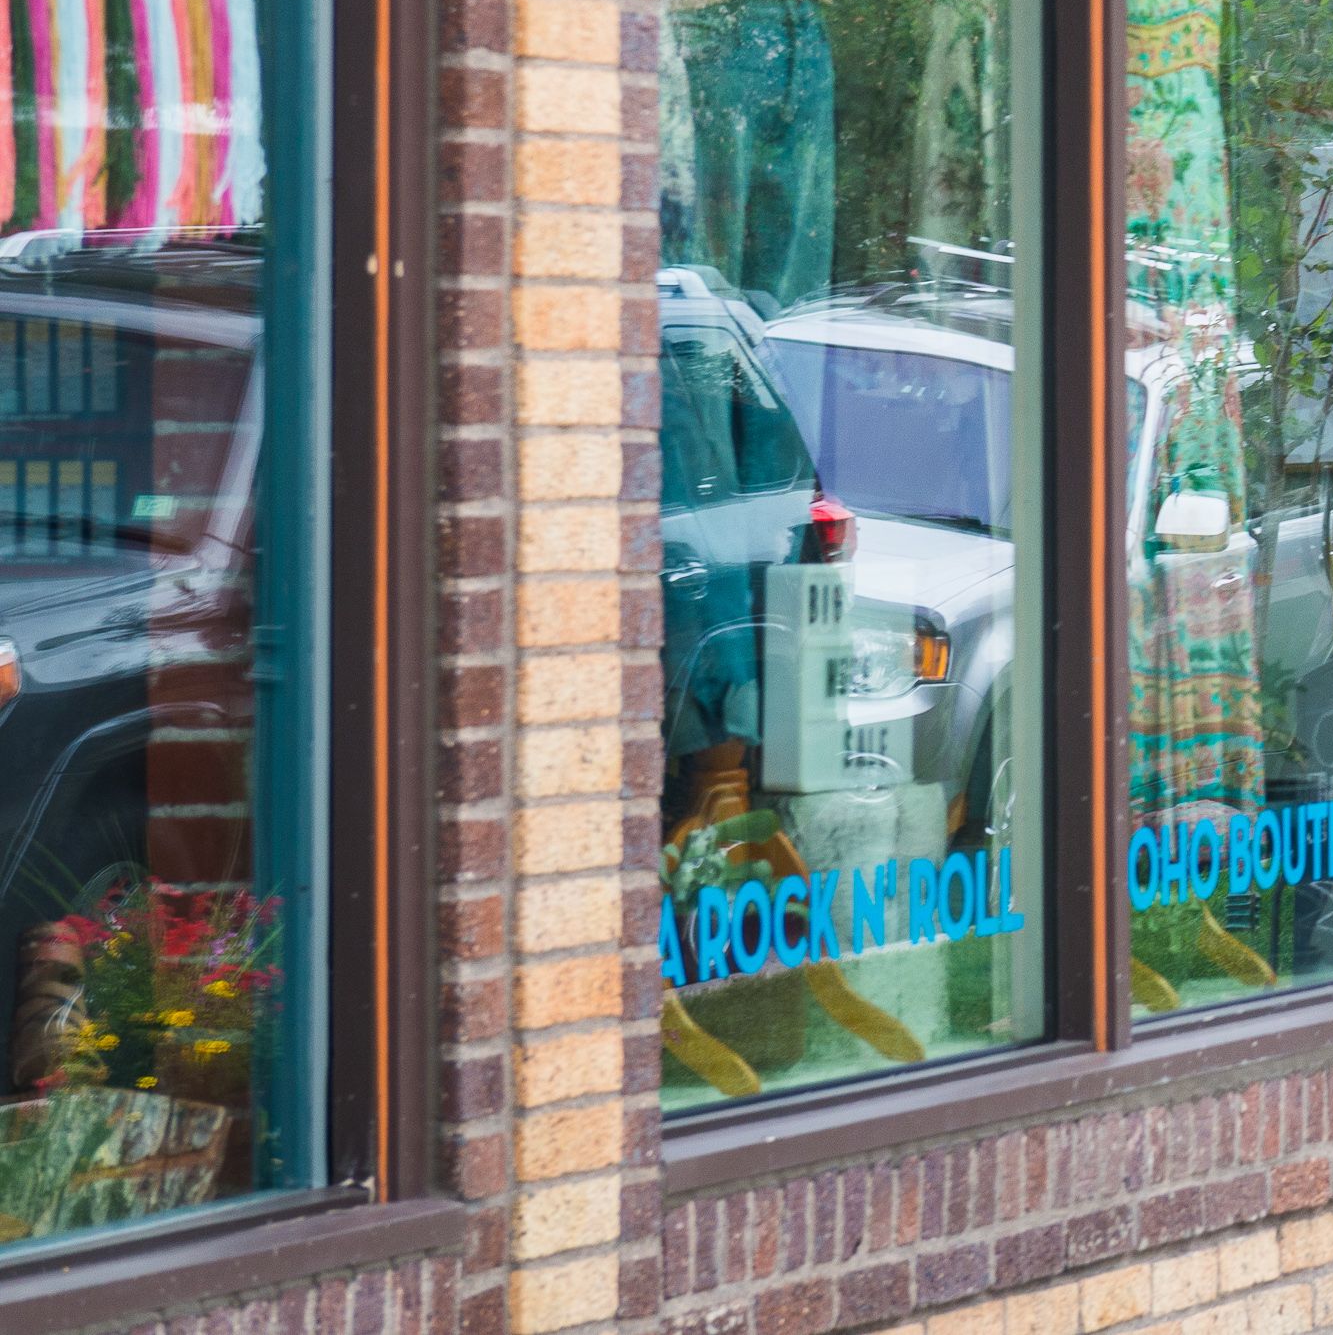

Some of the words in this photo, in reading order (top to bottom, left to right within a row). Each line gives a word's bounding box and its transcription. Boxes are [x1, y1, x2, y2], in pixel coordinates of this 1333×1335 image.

[699, 868, 841, 983] ROCK
[852, 858, 898, 955] N'
[908, 846, 1025, 945] ROLL
[1128, 818, 1221, 912] OHO
